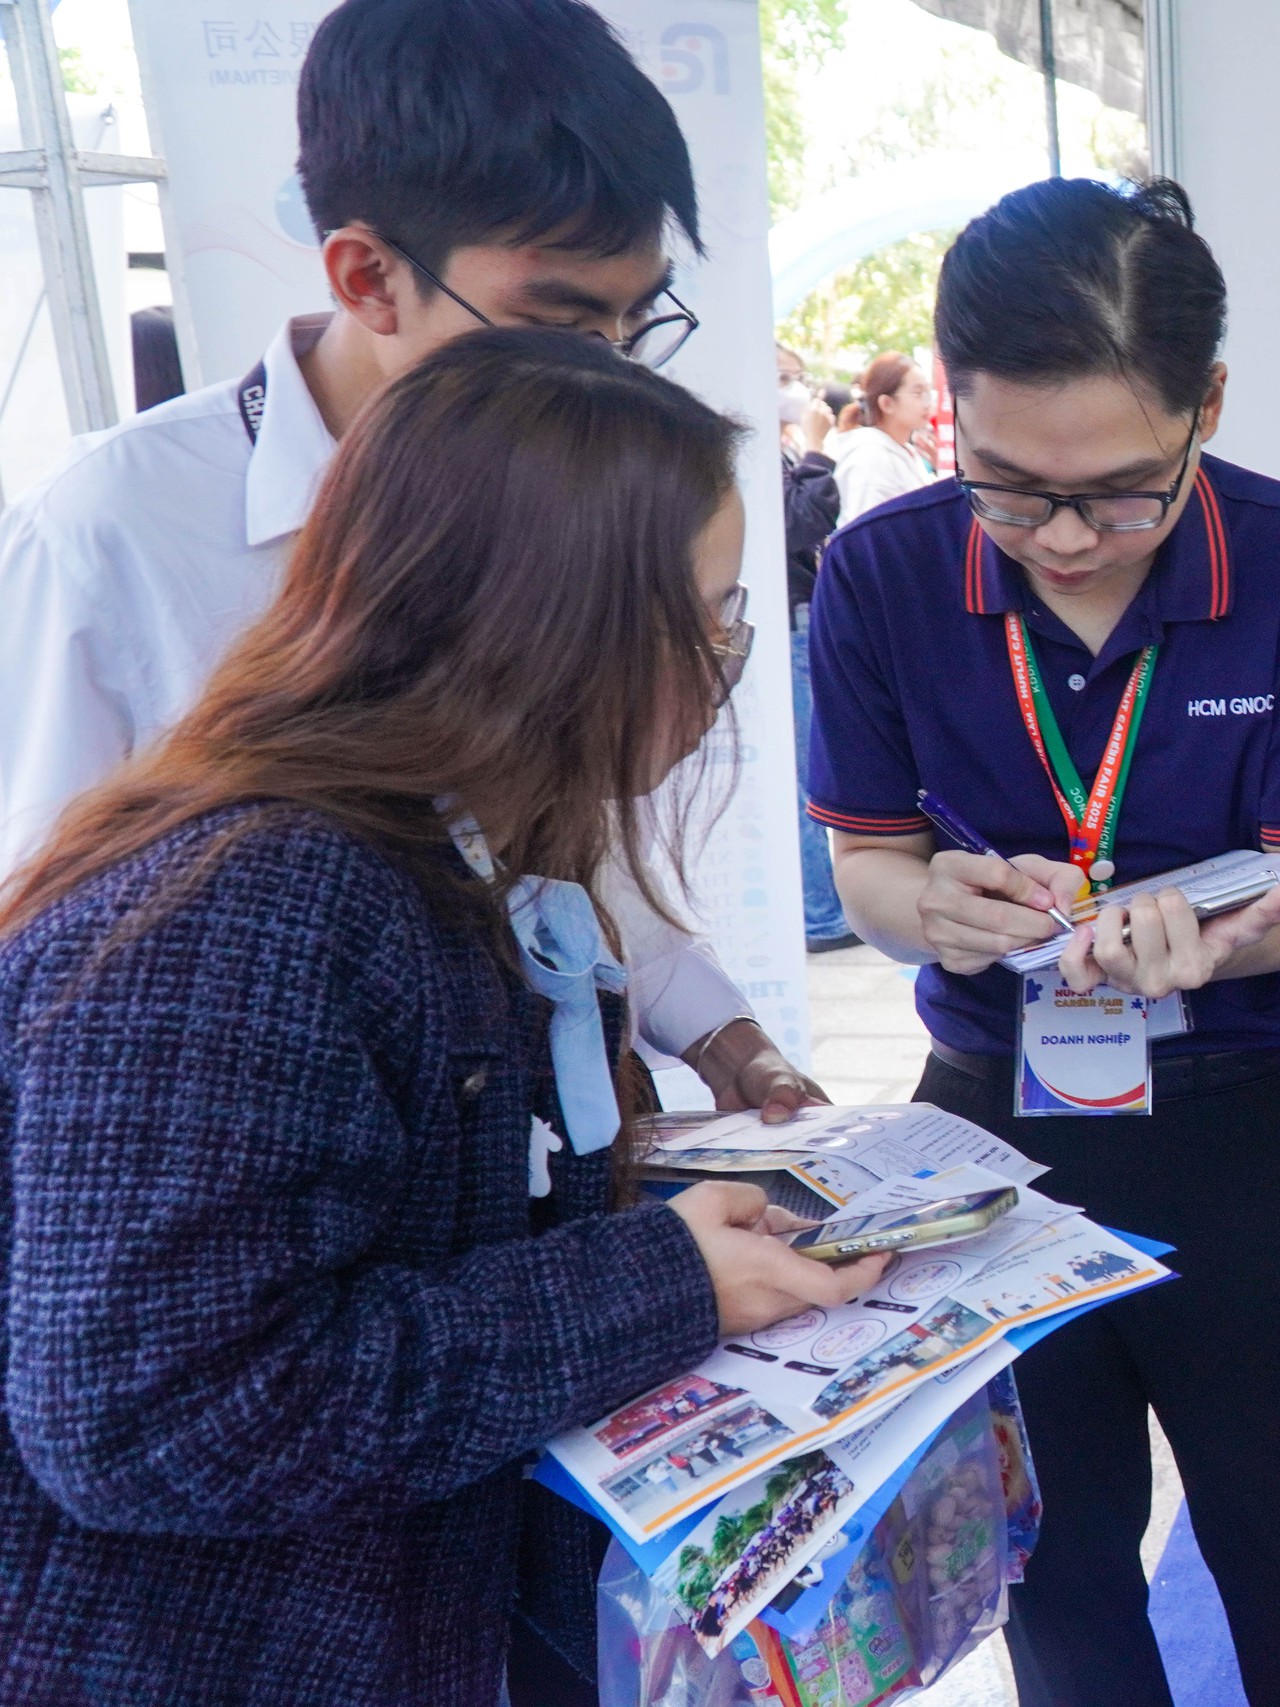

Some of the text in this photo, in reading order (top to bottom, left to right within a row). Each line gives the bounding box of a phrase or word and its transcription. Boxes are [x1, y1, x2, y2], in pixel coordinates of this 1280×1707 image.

[1188, 694, 1275, 716] HCM GNOC
[1096, 767, 1113, 798] FAIR
[1086, 801, 1102, 830] 2025
[1041, 1032, 1131, 1046] DOANH NGHIỆP
